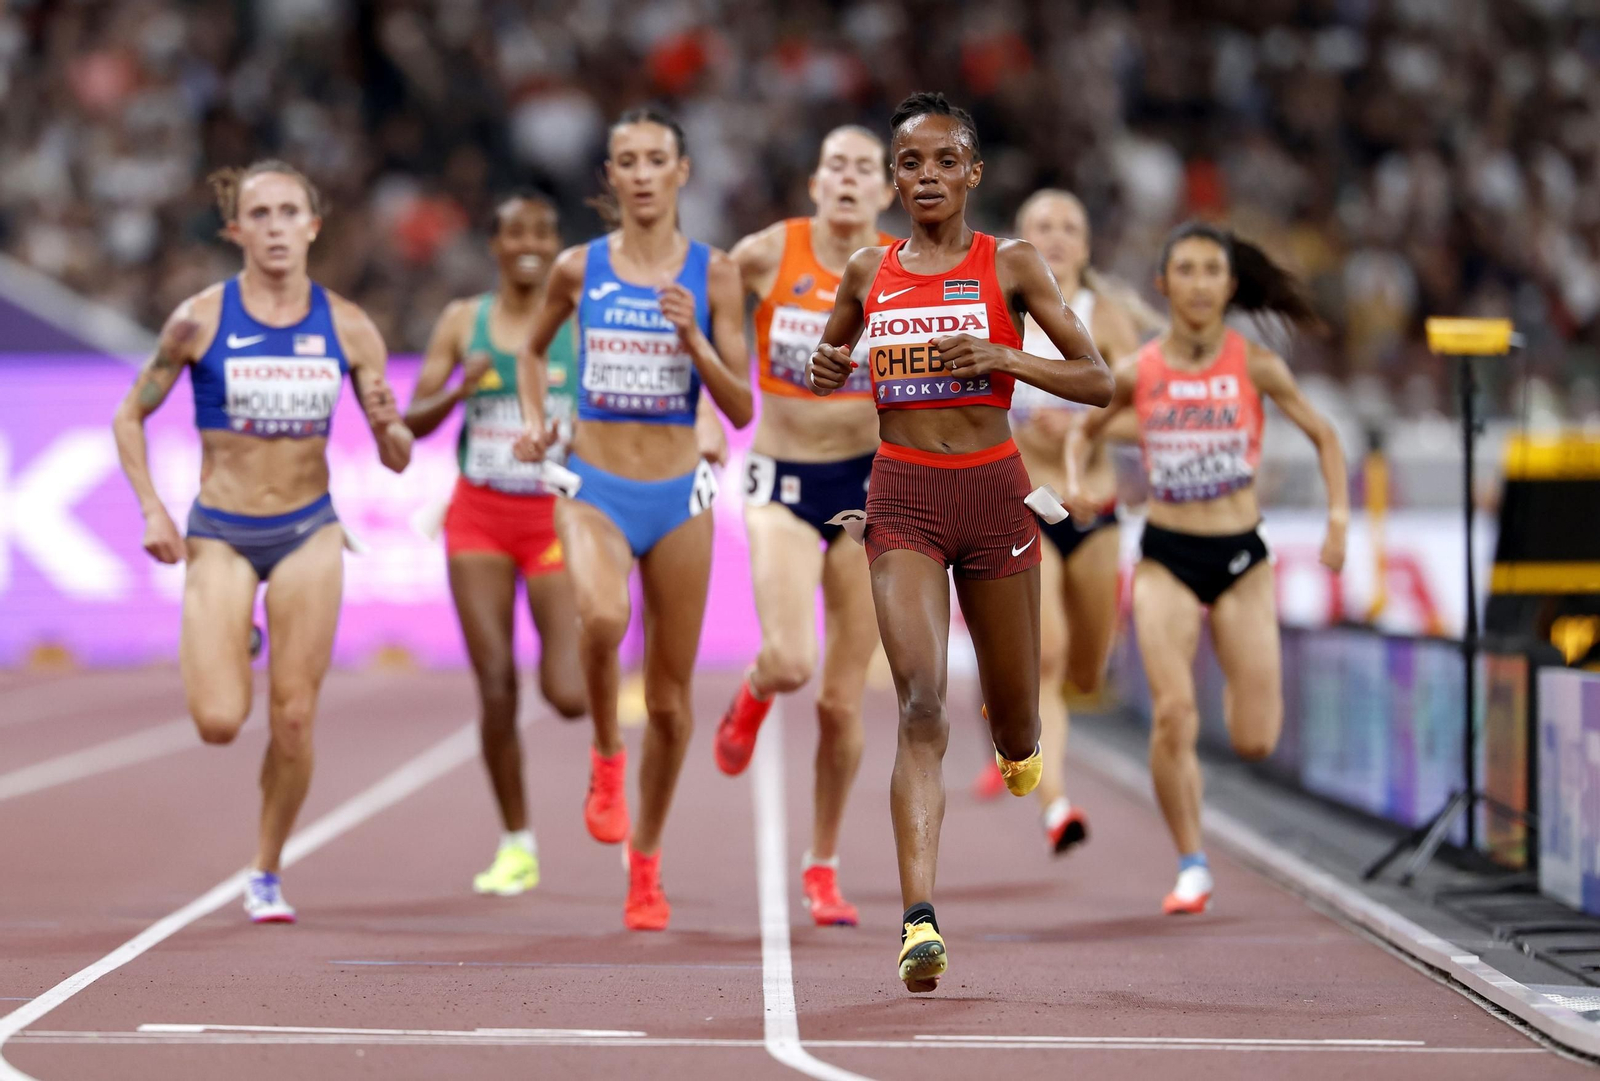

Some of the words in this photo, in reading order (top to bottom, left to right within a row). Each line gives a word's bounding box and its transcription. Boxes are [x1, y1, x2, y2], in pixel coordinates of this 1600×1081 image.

[869, 314, 986, 338] HONDA
[230, 365, 335, 381] HONDA
[875, 346, 946, 377] CHEB
